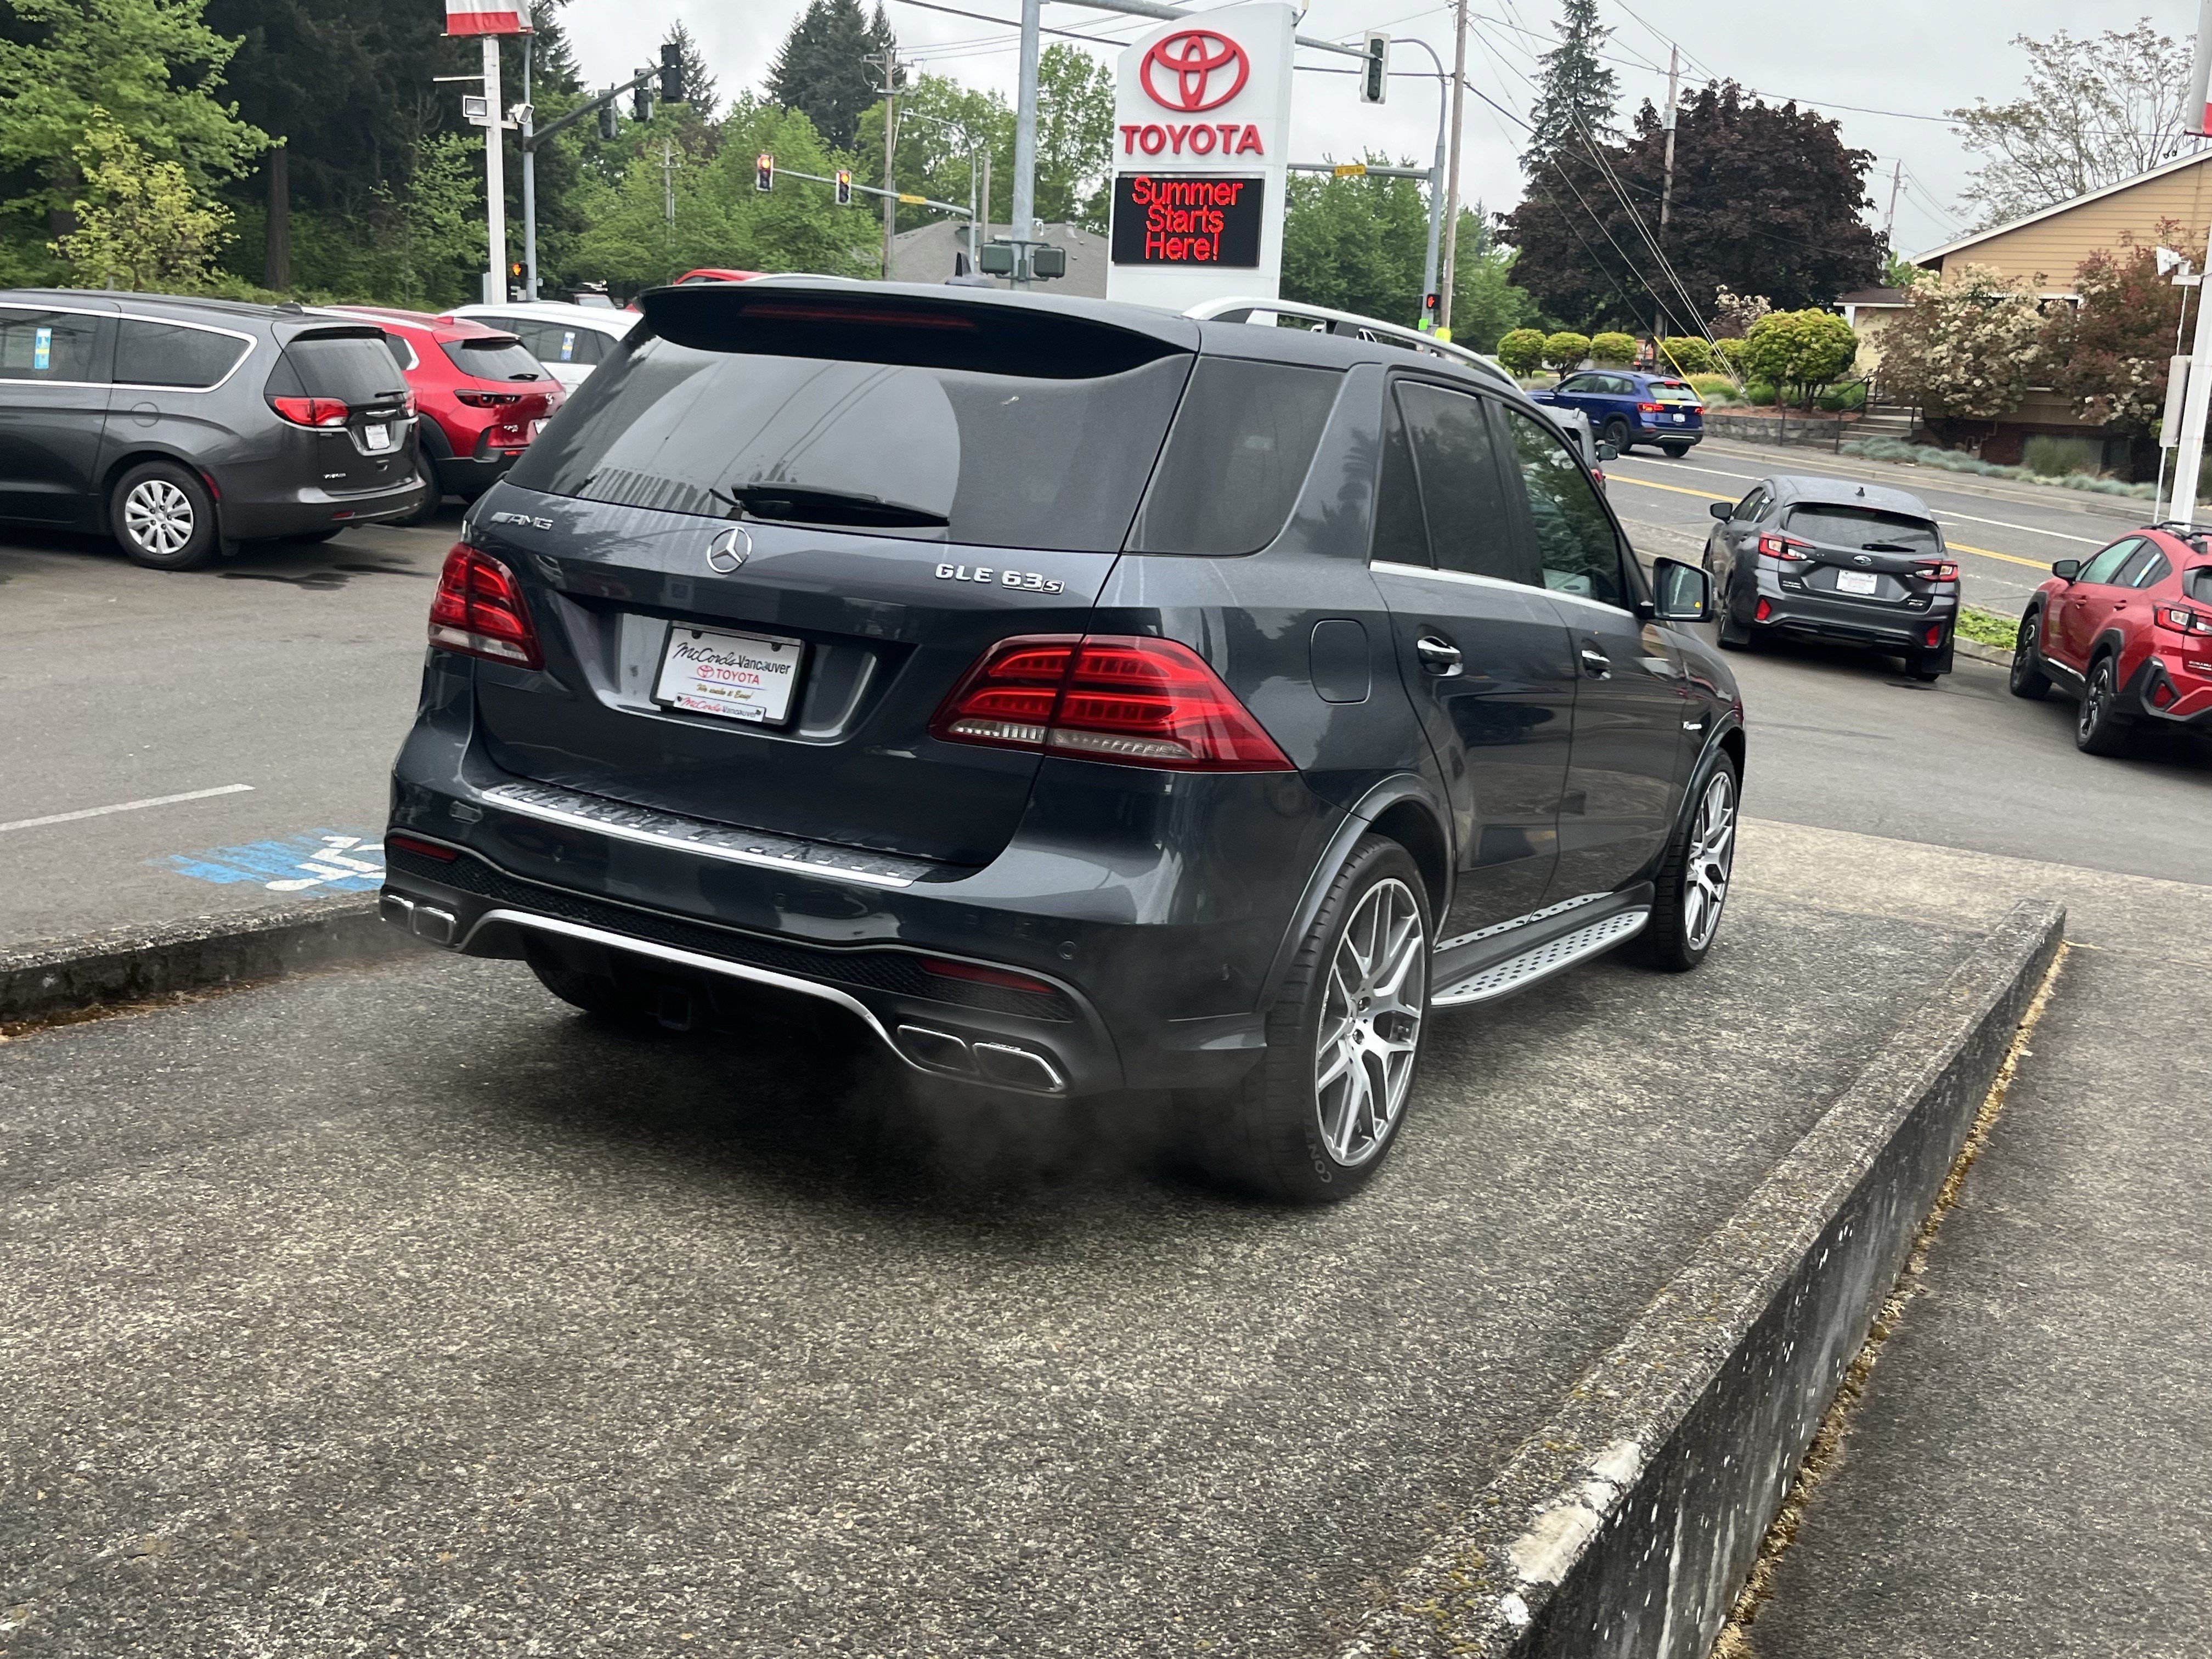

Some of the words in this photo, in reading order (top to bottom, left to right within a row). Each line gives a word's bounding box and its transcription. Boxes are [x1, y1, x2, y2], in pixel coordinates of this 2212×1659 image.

[1119, 123, 1264, 155] TOYOTA
[1132, 176, 1244, 206] Summer
[1146, 204, 1224, 233] Starts
[1145, 231, 1220, 261] Here!
[507, 514, 554, 530] AMG
[935, 563, 994, 583] GLE
[717, 669, 760, 685] TOYOTA
[738, 655, 791, 675] Vancouver
